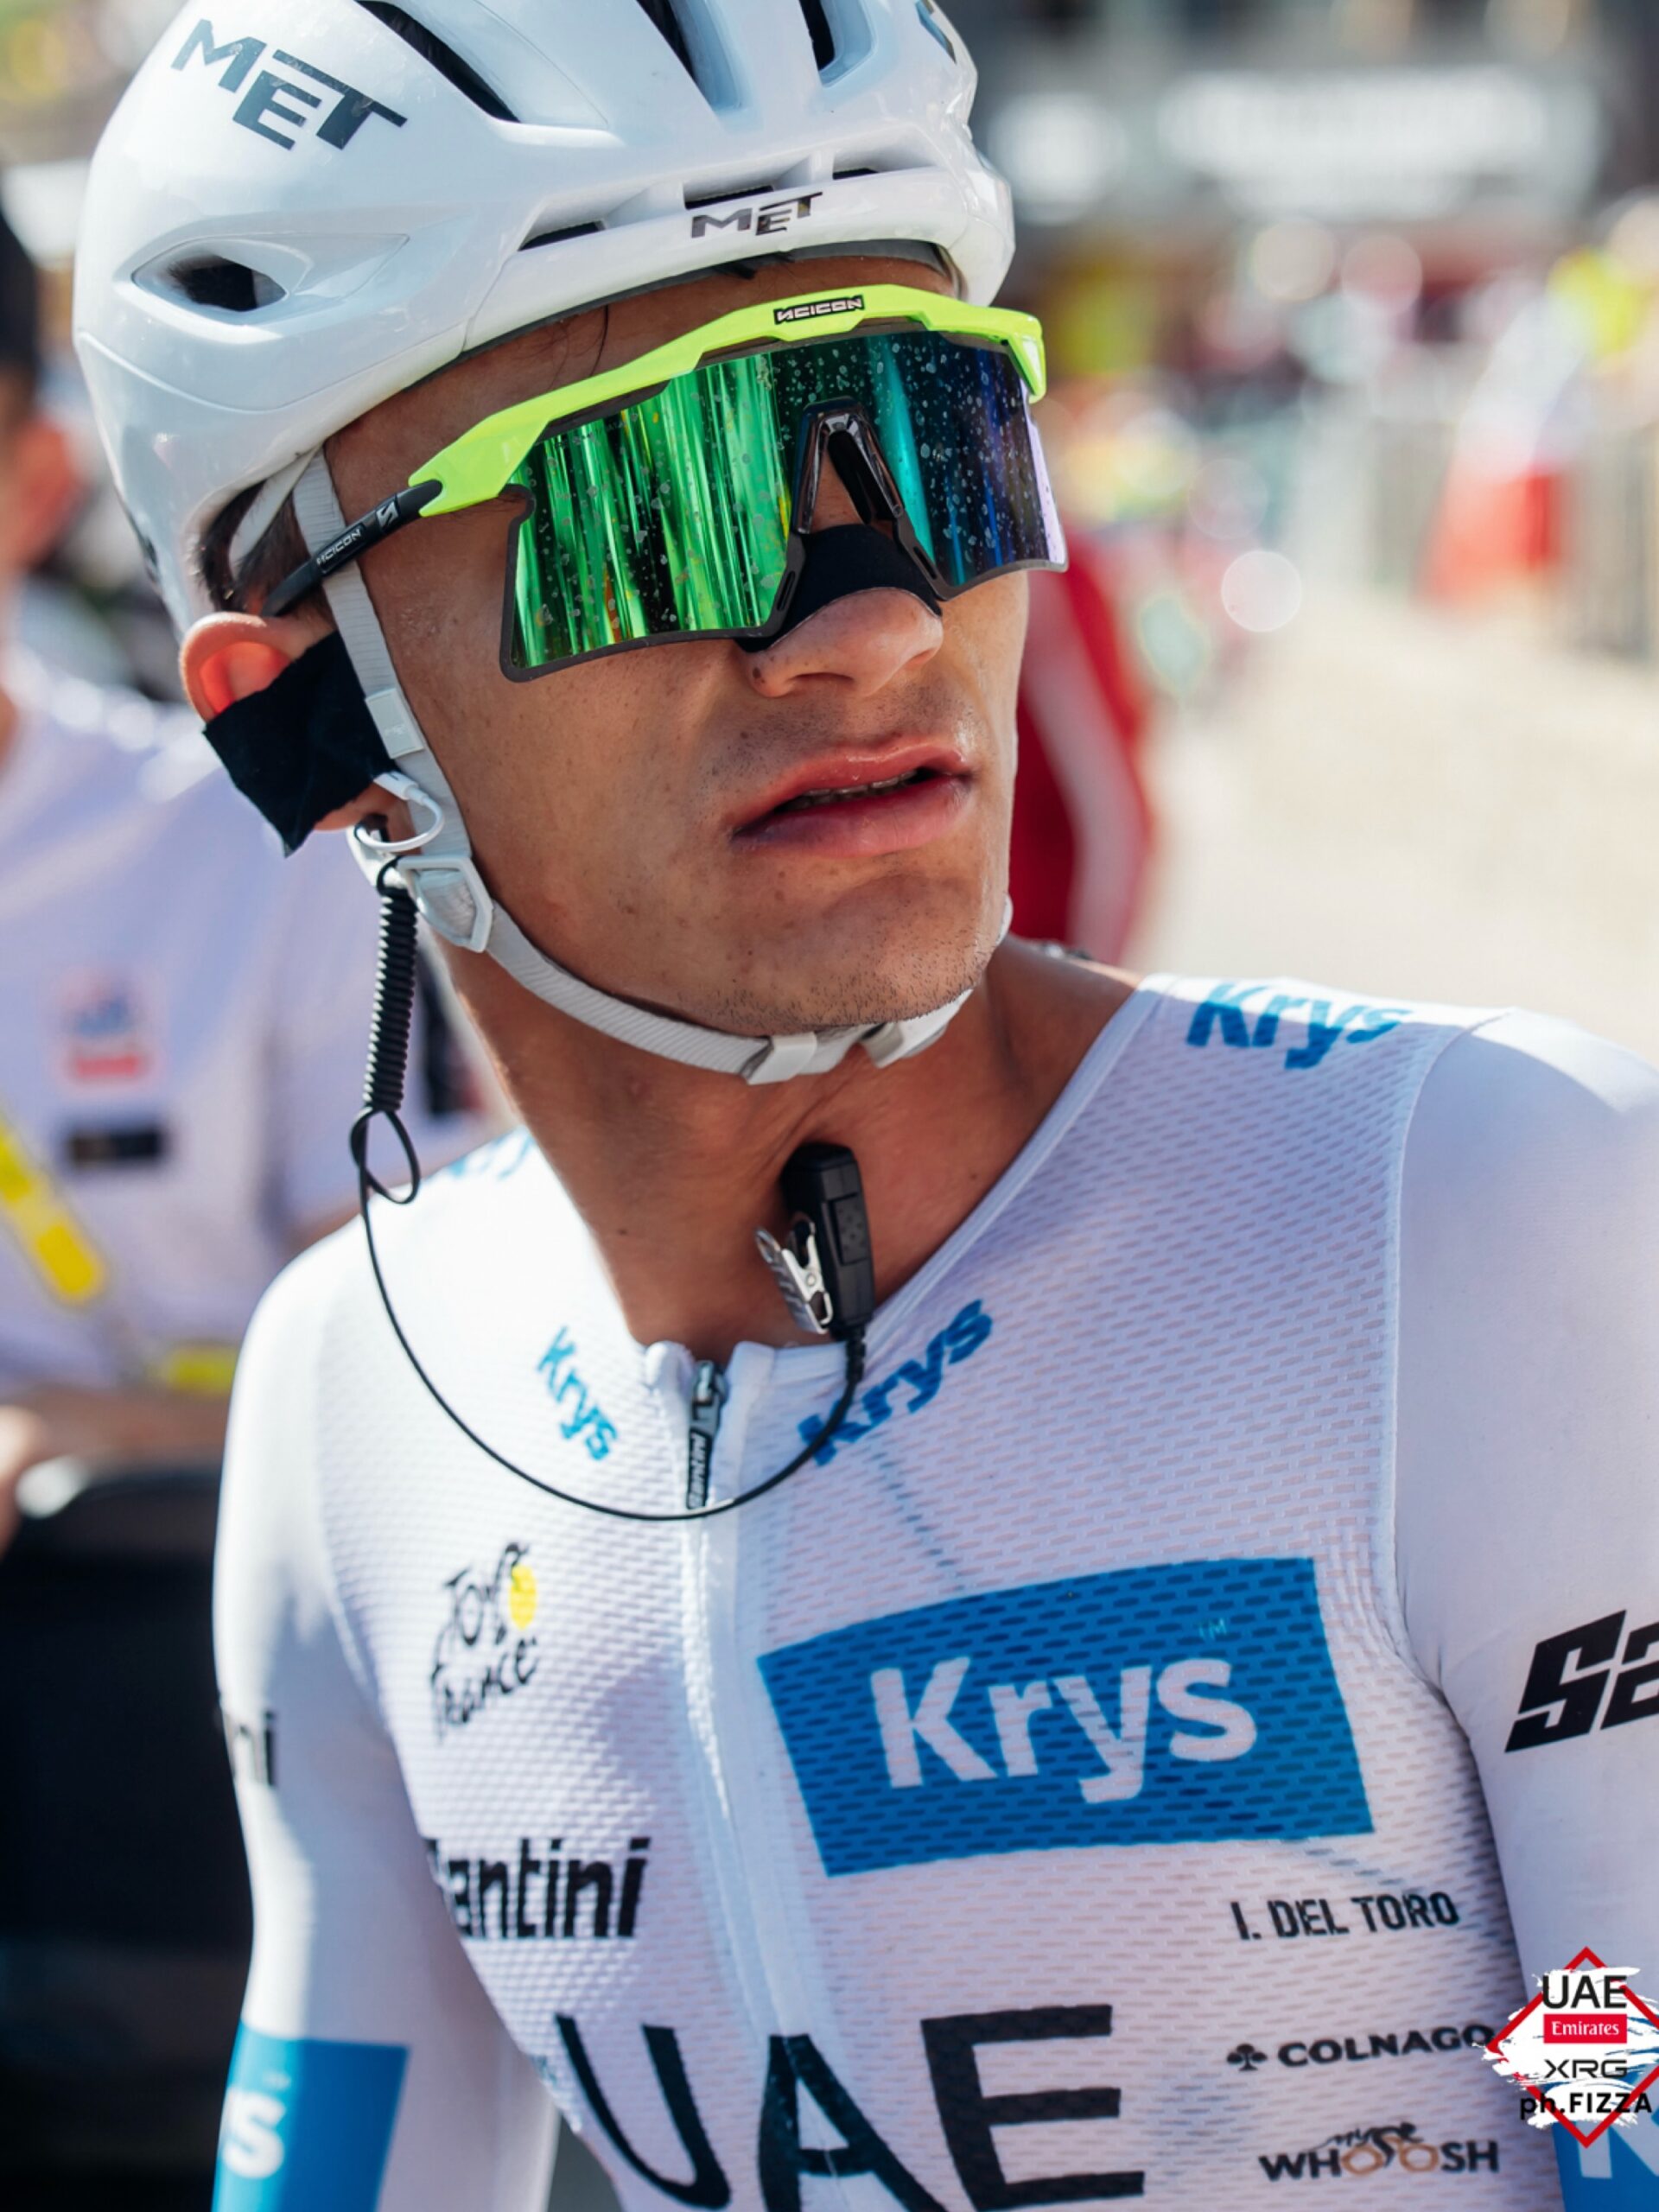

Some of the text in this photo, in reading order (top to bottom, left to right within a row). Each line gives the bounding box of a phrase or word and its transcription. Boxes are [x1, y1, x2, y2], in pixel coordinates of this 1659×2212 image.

[171, 19, 408, 150] MET
[691, 191, 823, 238] MET
[1186, 982, 1412, 1070] Krys
[537, 1325, 618, 1460] Krys
[797, 1299, 993, 1467] Krys
[870, 1657, 1258, 1804] Krys
[429, 1837, 651, 1938] antini
[1230, 1891, 1460, 1941] I. DEL TORO
[1277, 2023, 1497, 2068] COLNAGO
[553, 2003, 1146, 2212] UAE
[1258, 2139, 1499, 2182] WHOOSH
